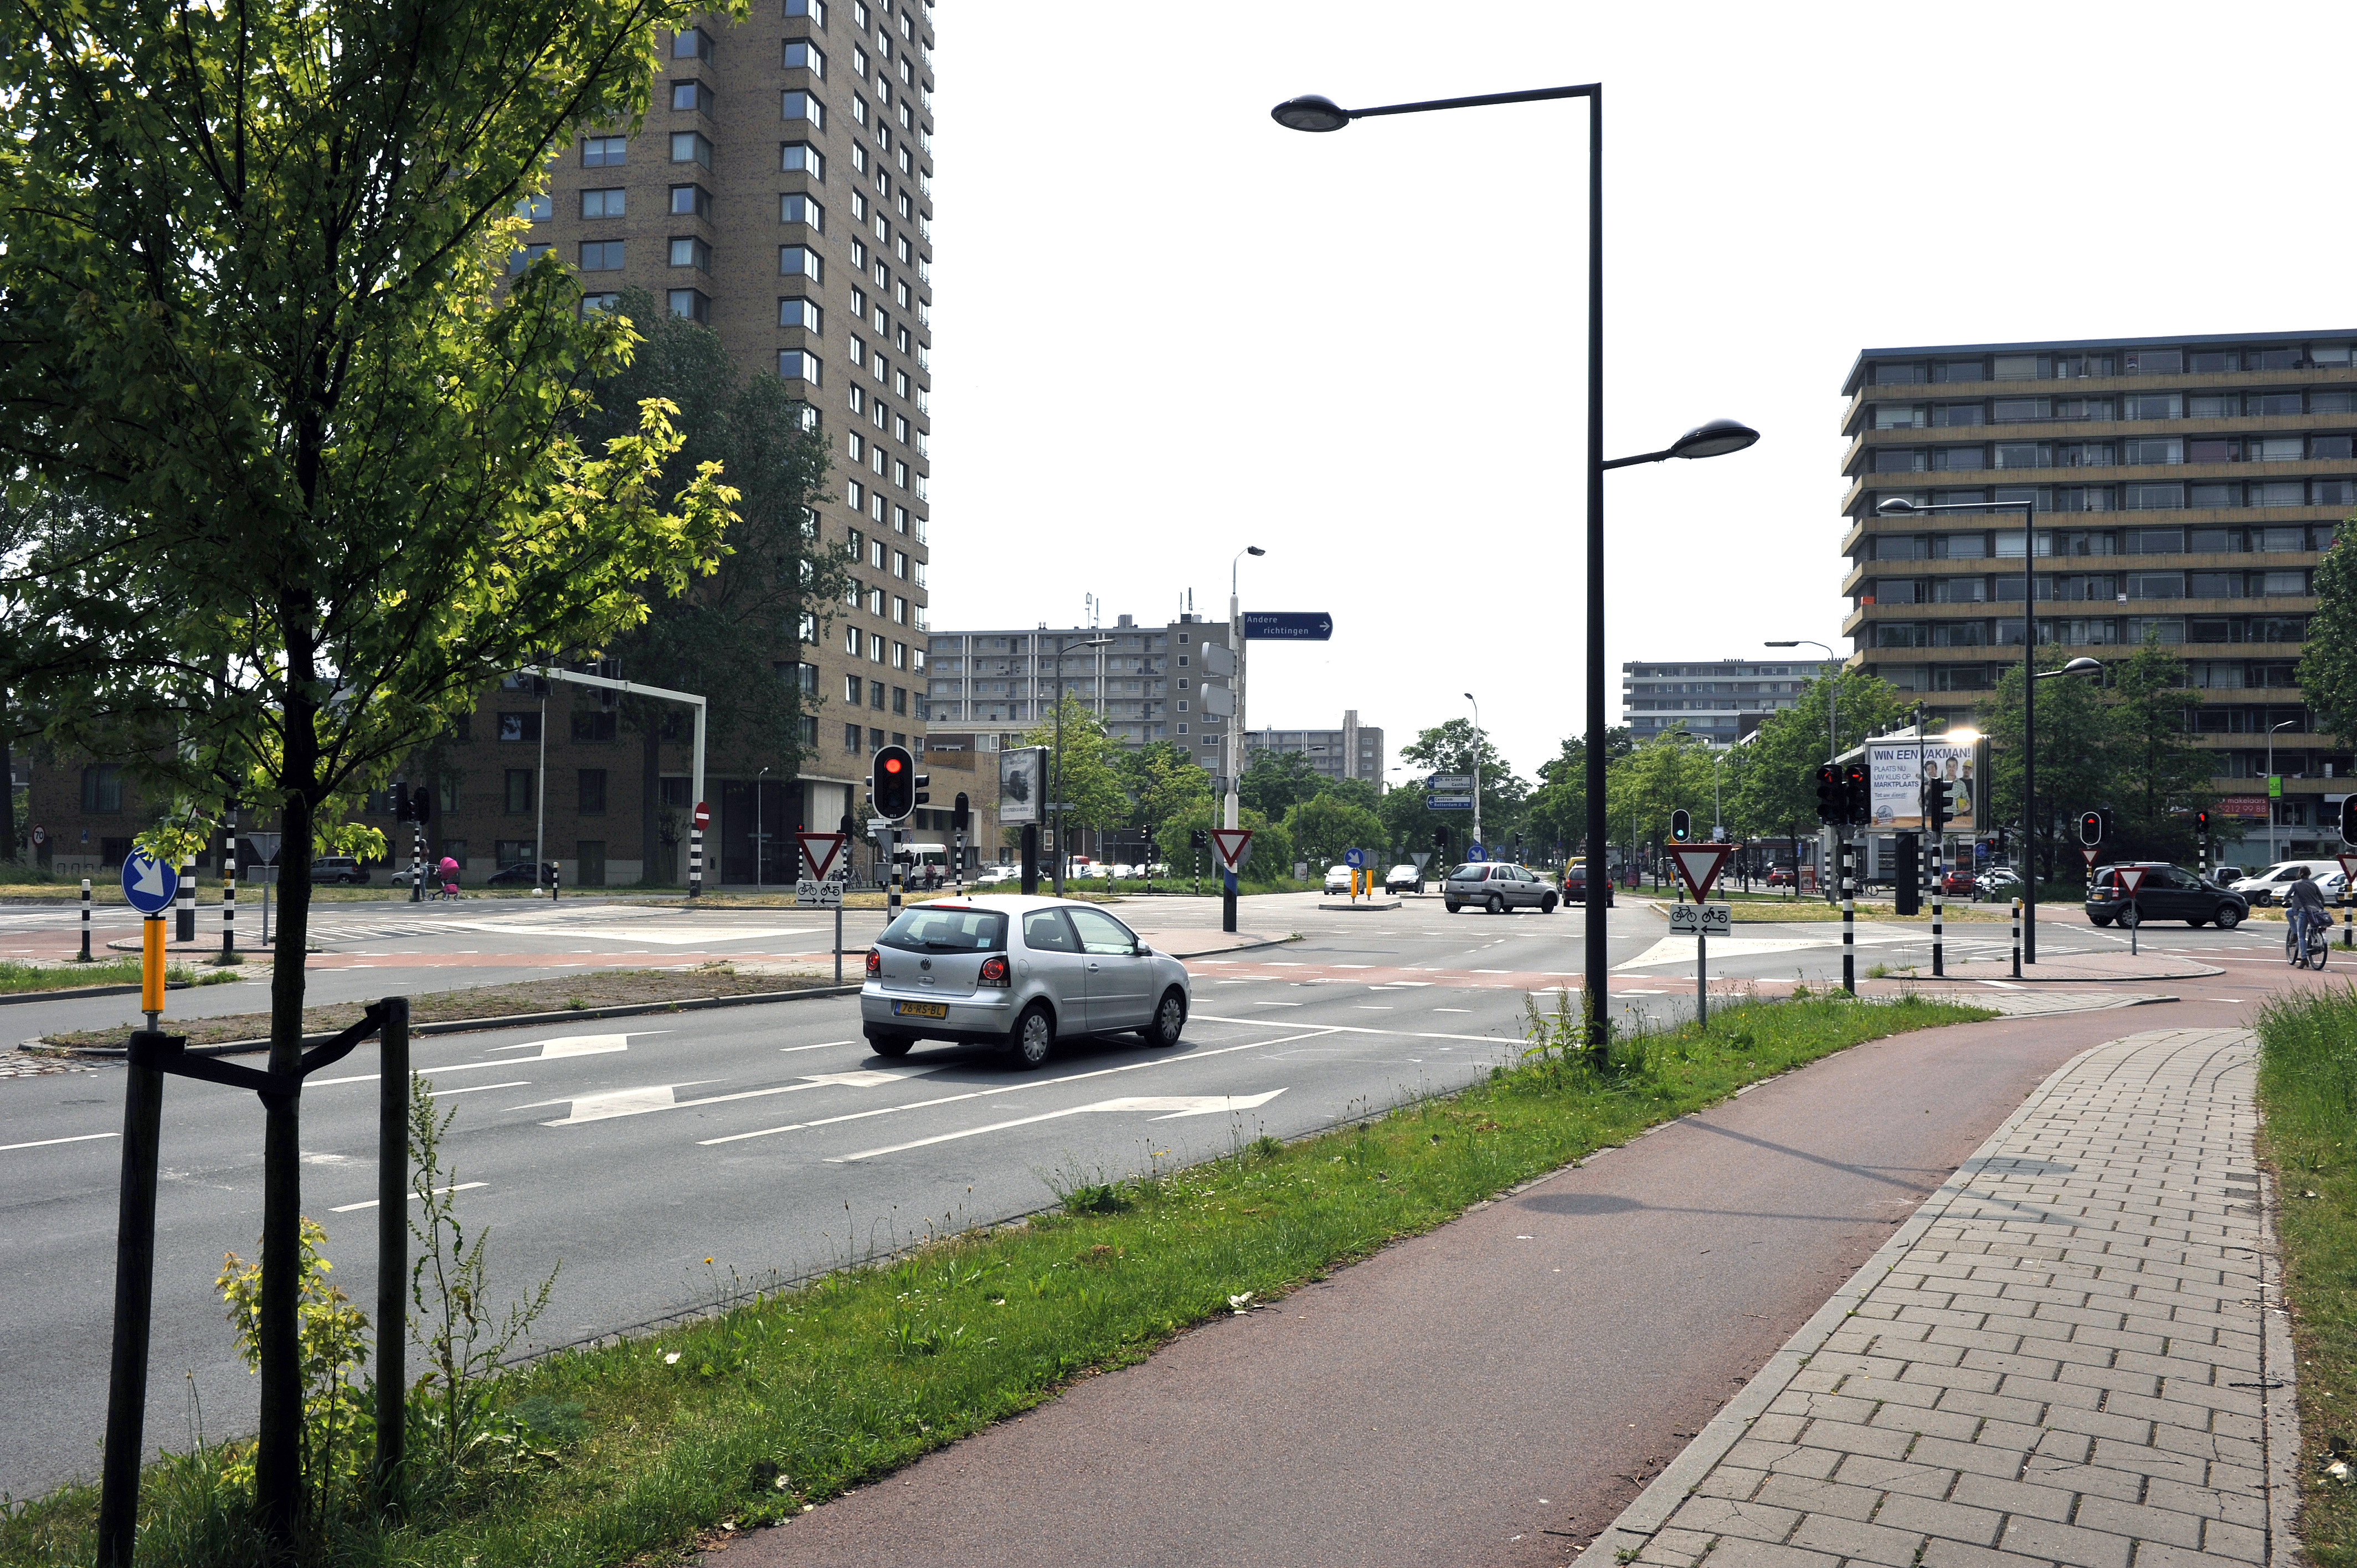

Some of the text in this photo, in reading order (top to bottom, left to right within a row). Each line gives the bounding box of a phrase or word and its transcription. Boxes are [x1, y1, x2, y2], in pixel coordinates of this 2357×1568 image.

[1263, 627, 1309, 636] richtingen
[1874, 747, 1970, 760] WIN EEN VAKMAN!
[35, 831, 44, 839] 70
[902, 1003, 941, 1015] 76-RS-BL
